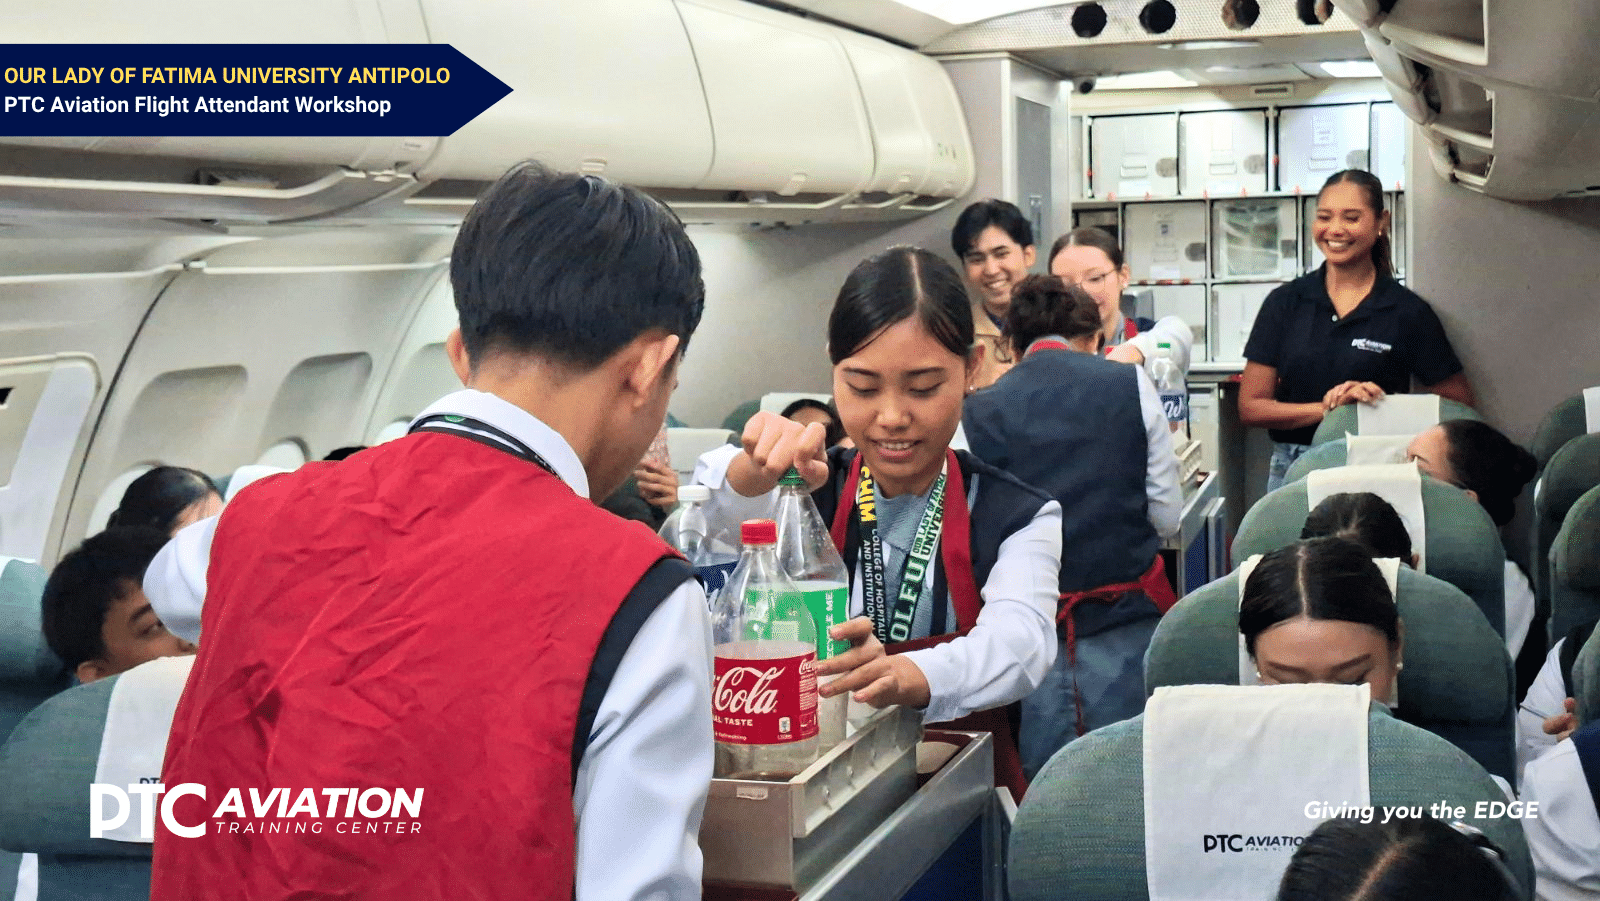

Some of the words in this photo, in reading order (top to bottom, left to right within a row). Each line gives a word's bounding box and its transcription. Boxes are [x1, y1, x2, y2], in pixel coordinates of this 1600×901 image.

[917, 513, 931, 535] LADY
[863, 540, 871, 560] AND
[872, 529, 883, 571] COLLEGE
[913, 538, 923, 553] OUR
[874, 572, 883, 586] OF
[825, 592, 834, 611] ME
[865, 562, 876, 630] INSTITUTION
[890, 559, 925, 642] OLFU
[875, 588, 887, 642] HOSPITALIT
[724, 717, 753, 727] TASTE
[1204, 834, 1243, 853] PTC
[1245, 836, 1304, 847] AVIATIO
